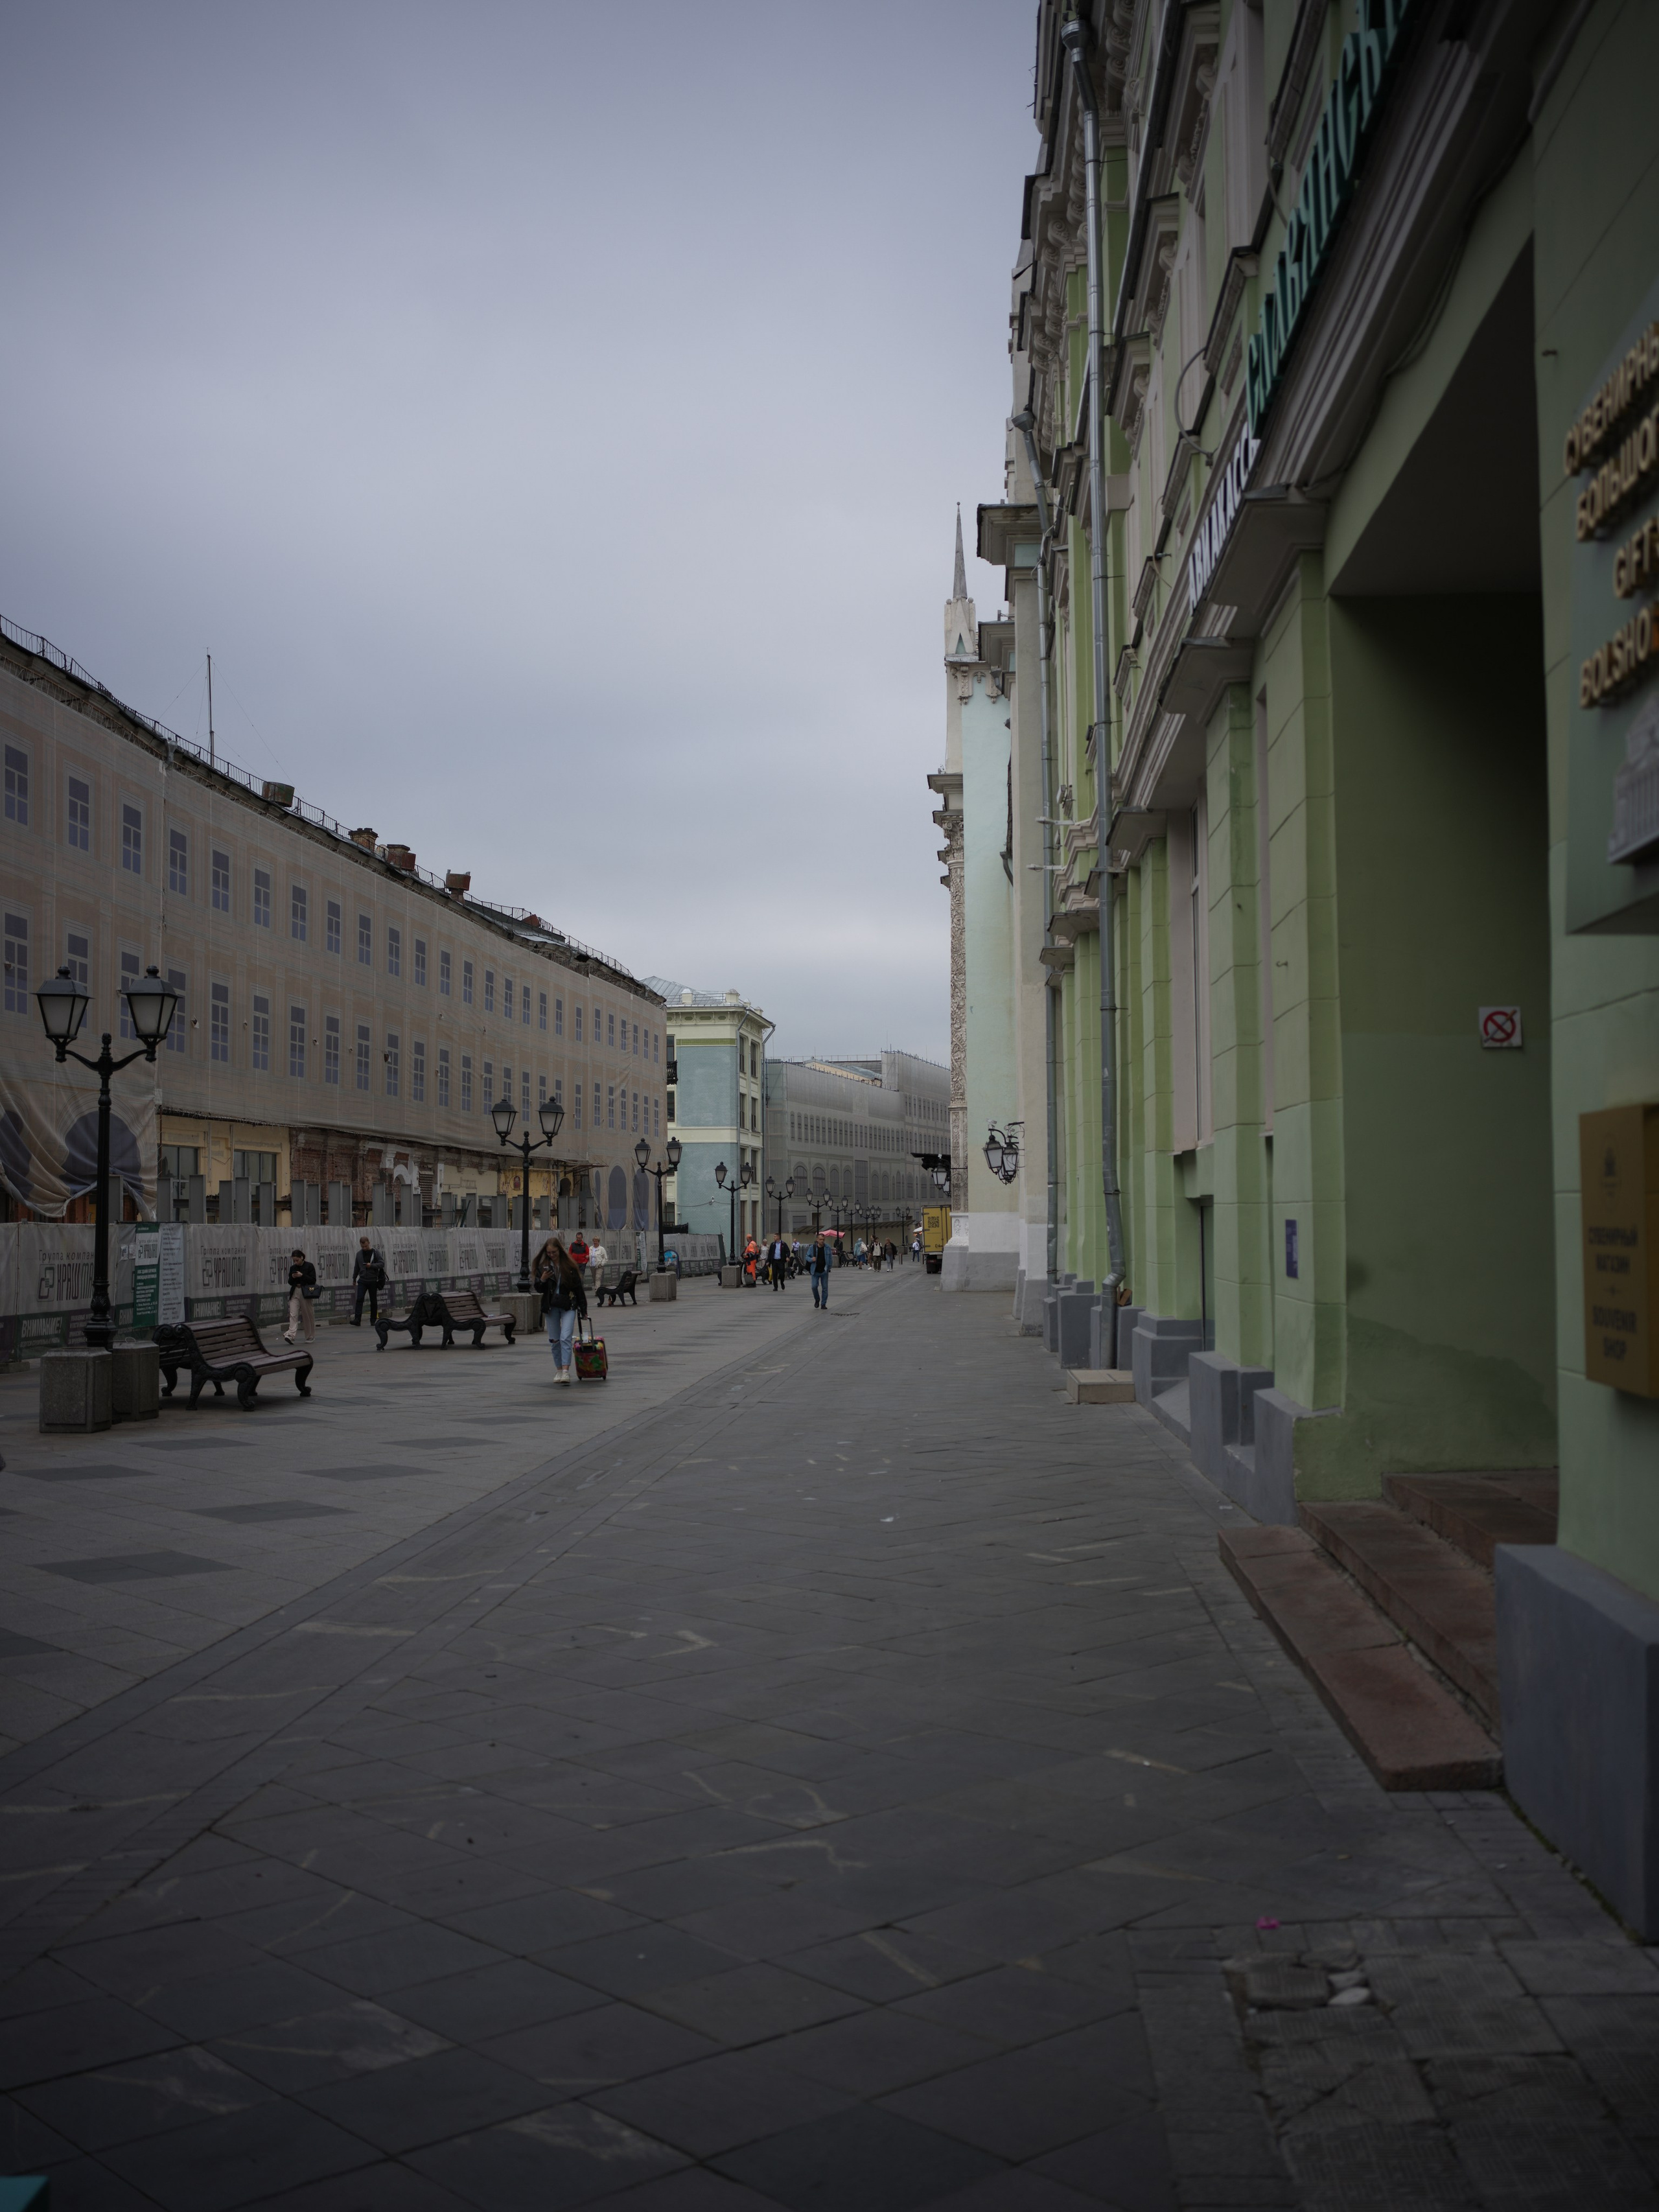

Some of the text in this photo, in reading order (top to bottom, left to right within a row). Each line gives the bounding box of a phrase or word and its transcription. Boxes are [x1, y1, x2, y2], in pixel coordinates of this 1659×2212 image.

[1612, 518, 1659, 598] GIFT
[40, 1250, 64, 1263] Группа
[222, 1246, 246, 1254] компаний
[57, 1263, 94, 1301] КРАШМА
[214, 1256, 246, 1288] КРАШМАШ
[21, 1316, 63, 1338] ВНИМАНИЕ!
[1592, 1305, 1637, 1333] SOUVENIR
[1603, 1336, 1627, 1360] SHOP
